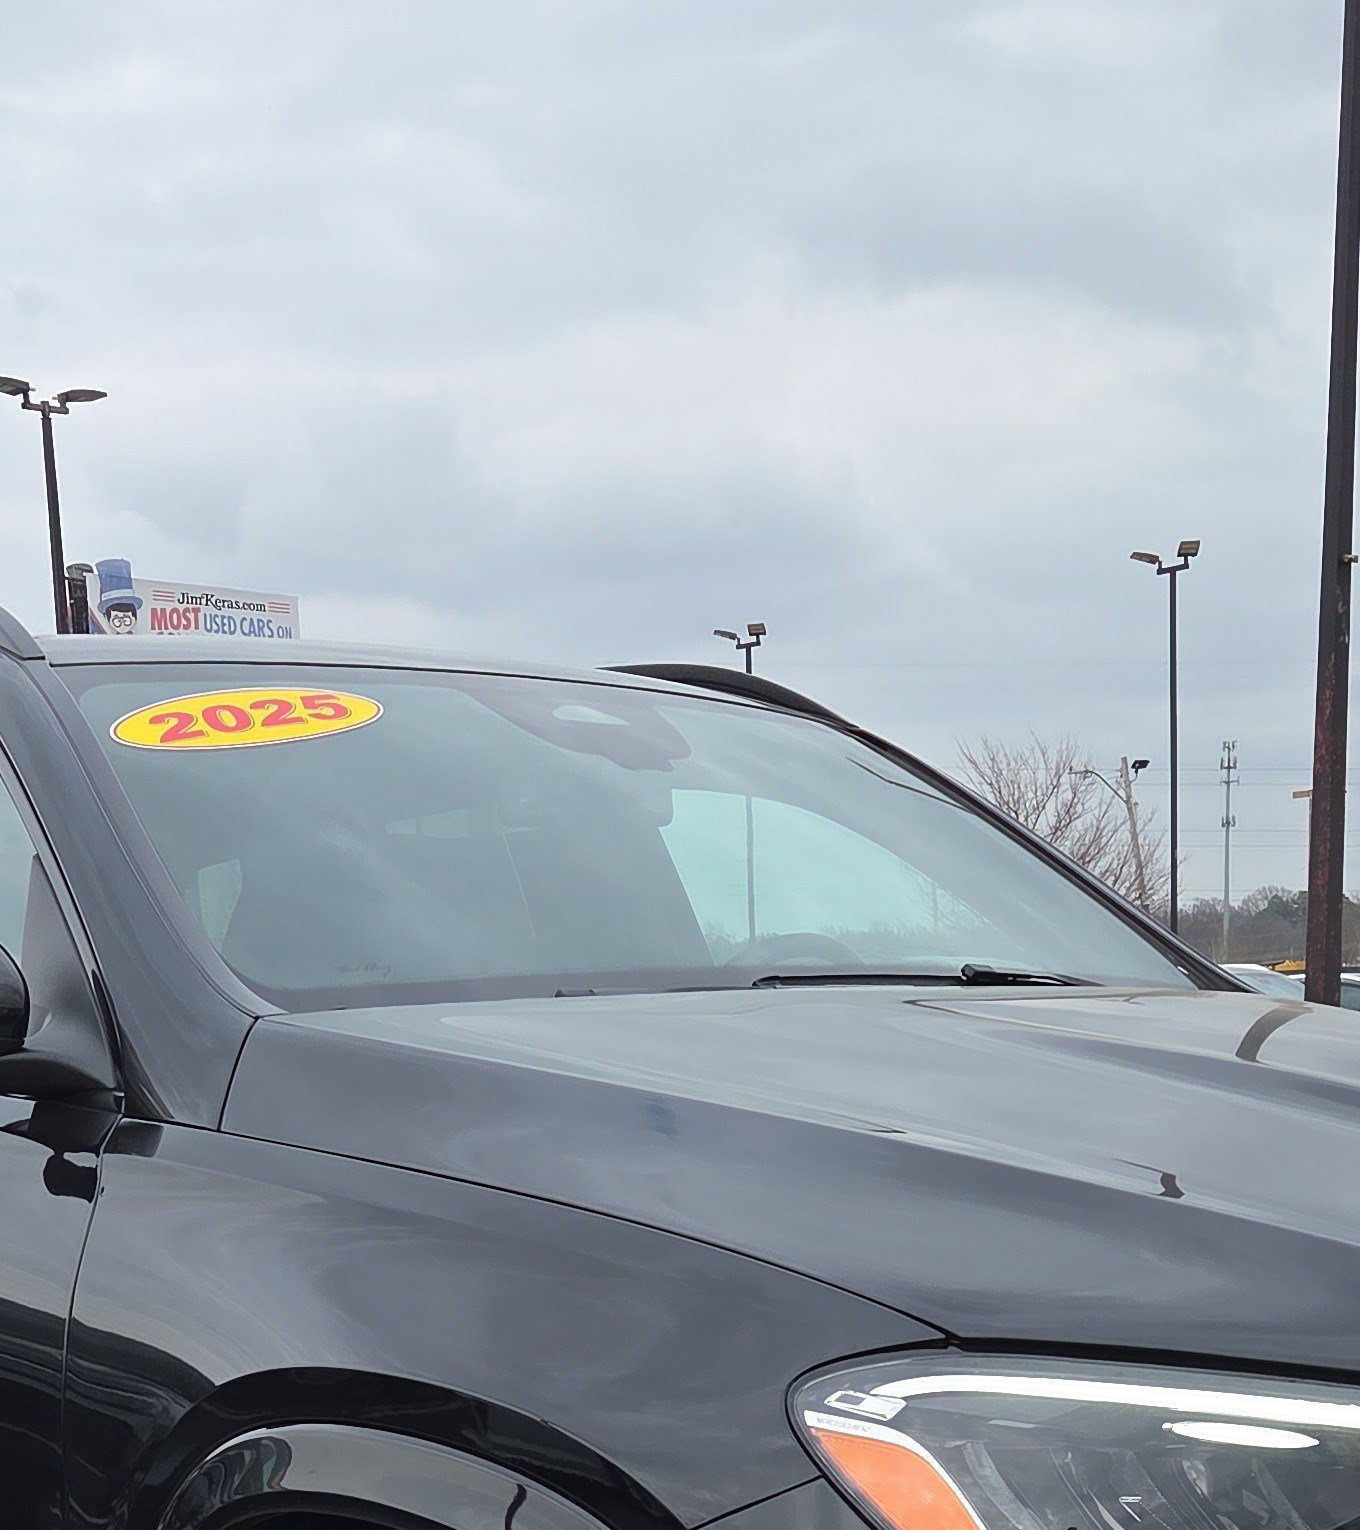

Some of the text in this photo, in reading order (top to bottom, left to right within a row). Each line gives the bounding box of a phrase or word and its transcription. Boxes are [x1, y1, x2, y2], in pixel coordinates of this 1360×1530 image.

[177, 592, 266, 612] JimKeras.com
[150, 607, 201, 630] MOST
[203, 613, 237, 635] USED
[240, 616, 274, 638] CARS
[149, 694, 352, 744] 2025
